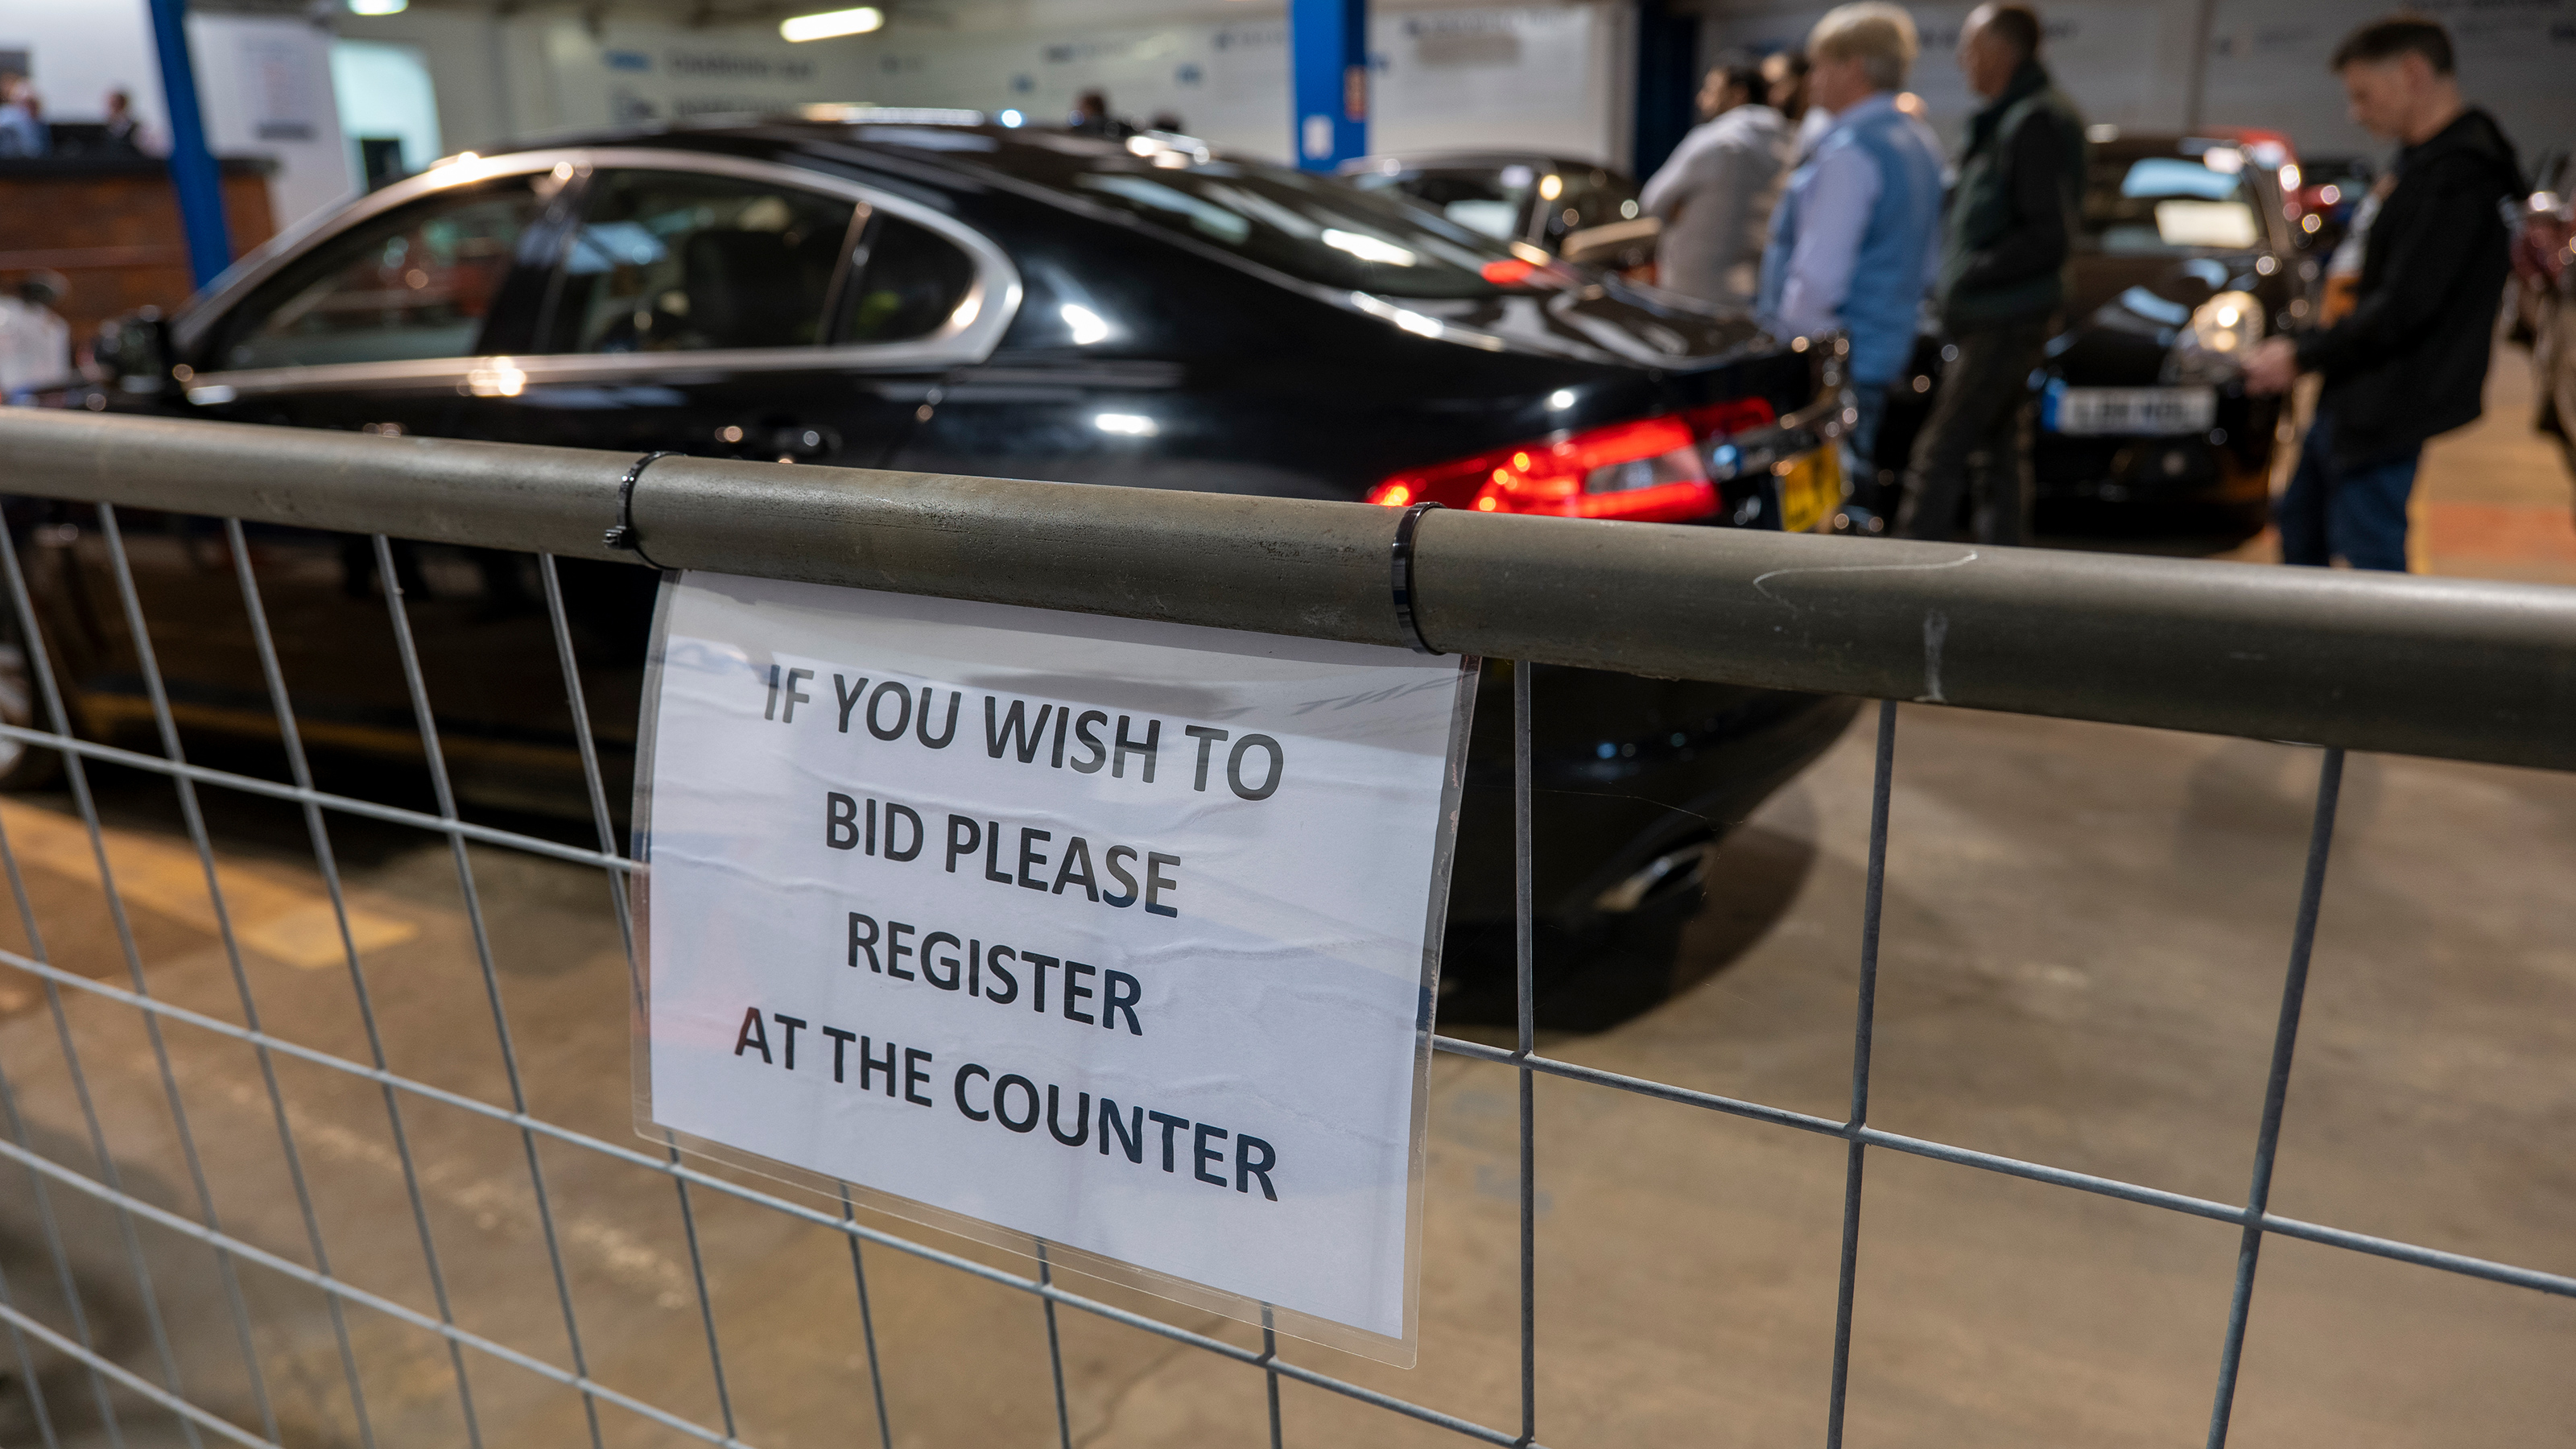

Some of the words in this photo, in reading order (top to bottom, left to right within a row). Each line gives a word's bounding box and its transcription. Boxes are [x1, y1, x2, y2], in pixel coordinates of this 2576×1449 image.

[764, 663, 814, 724] IF
[833, 673, 962, 749] YOU
[985, 696, 1162, 784] WISH
[1184, 724, 1284, 802] TO
[826, 791, 924, 863] BID
[945, 813, 1181, 919] PLEASE
[848, 911, 1143, 1037] REGISTER
[733, 1006, 807, 1071] AT
[822, 1025, 933, 1108] THE
[954, 1063, 1279, 1203] COUNTER
